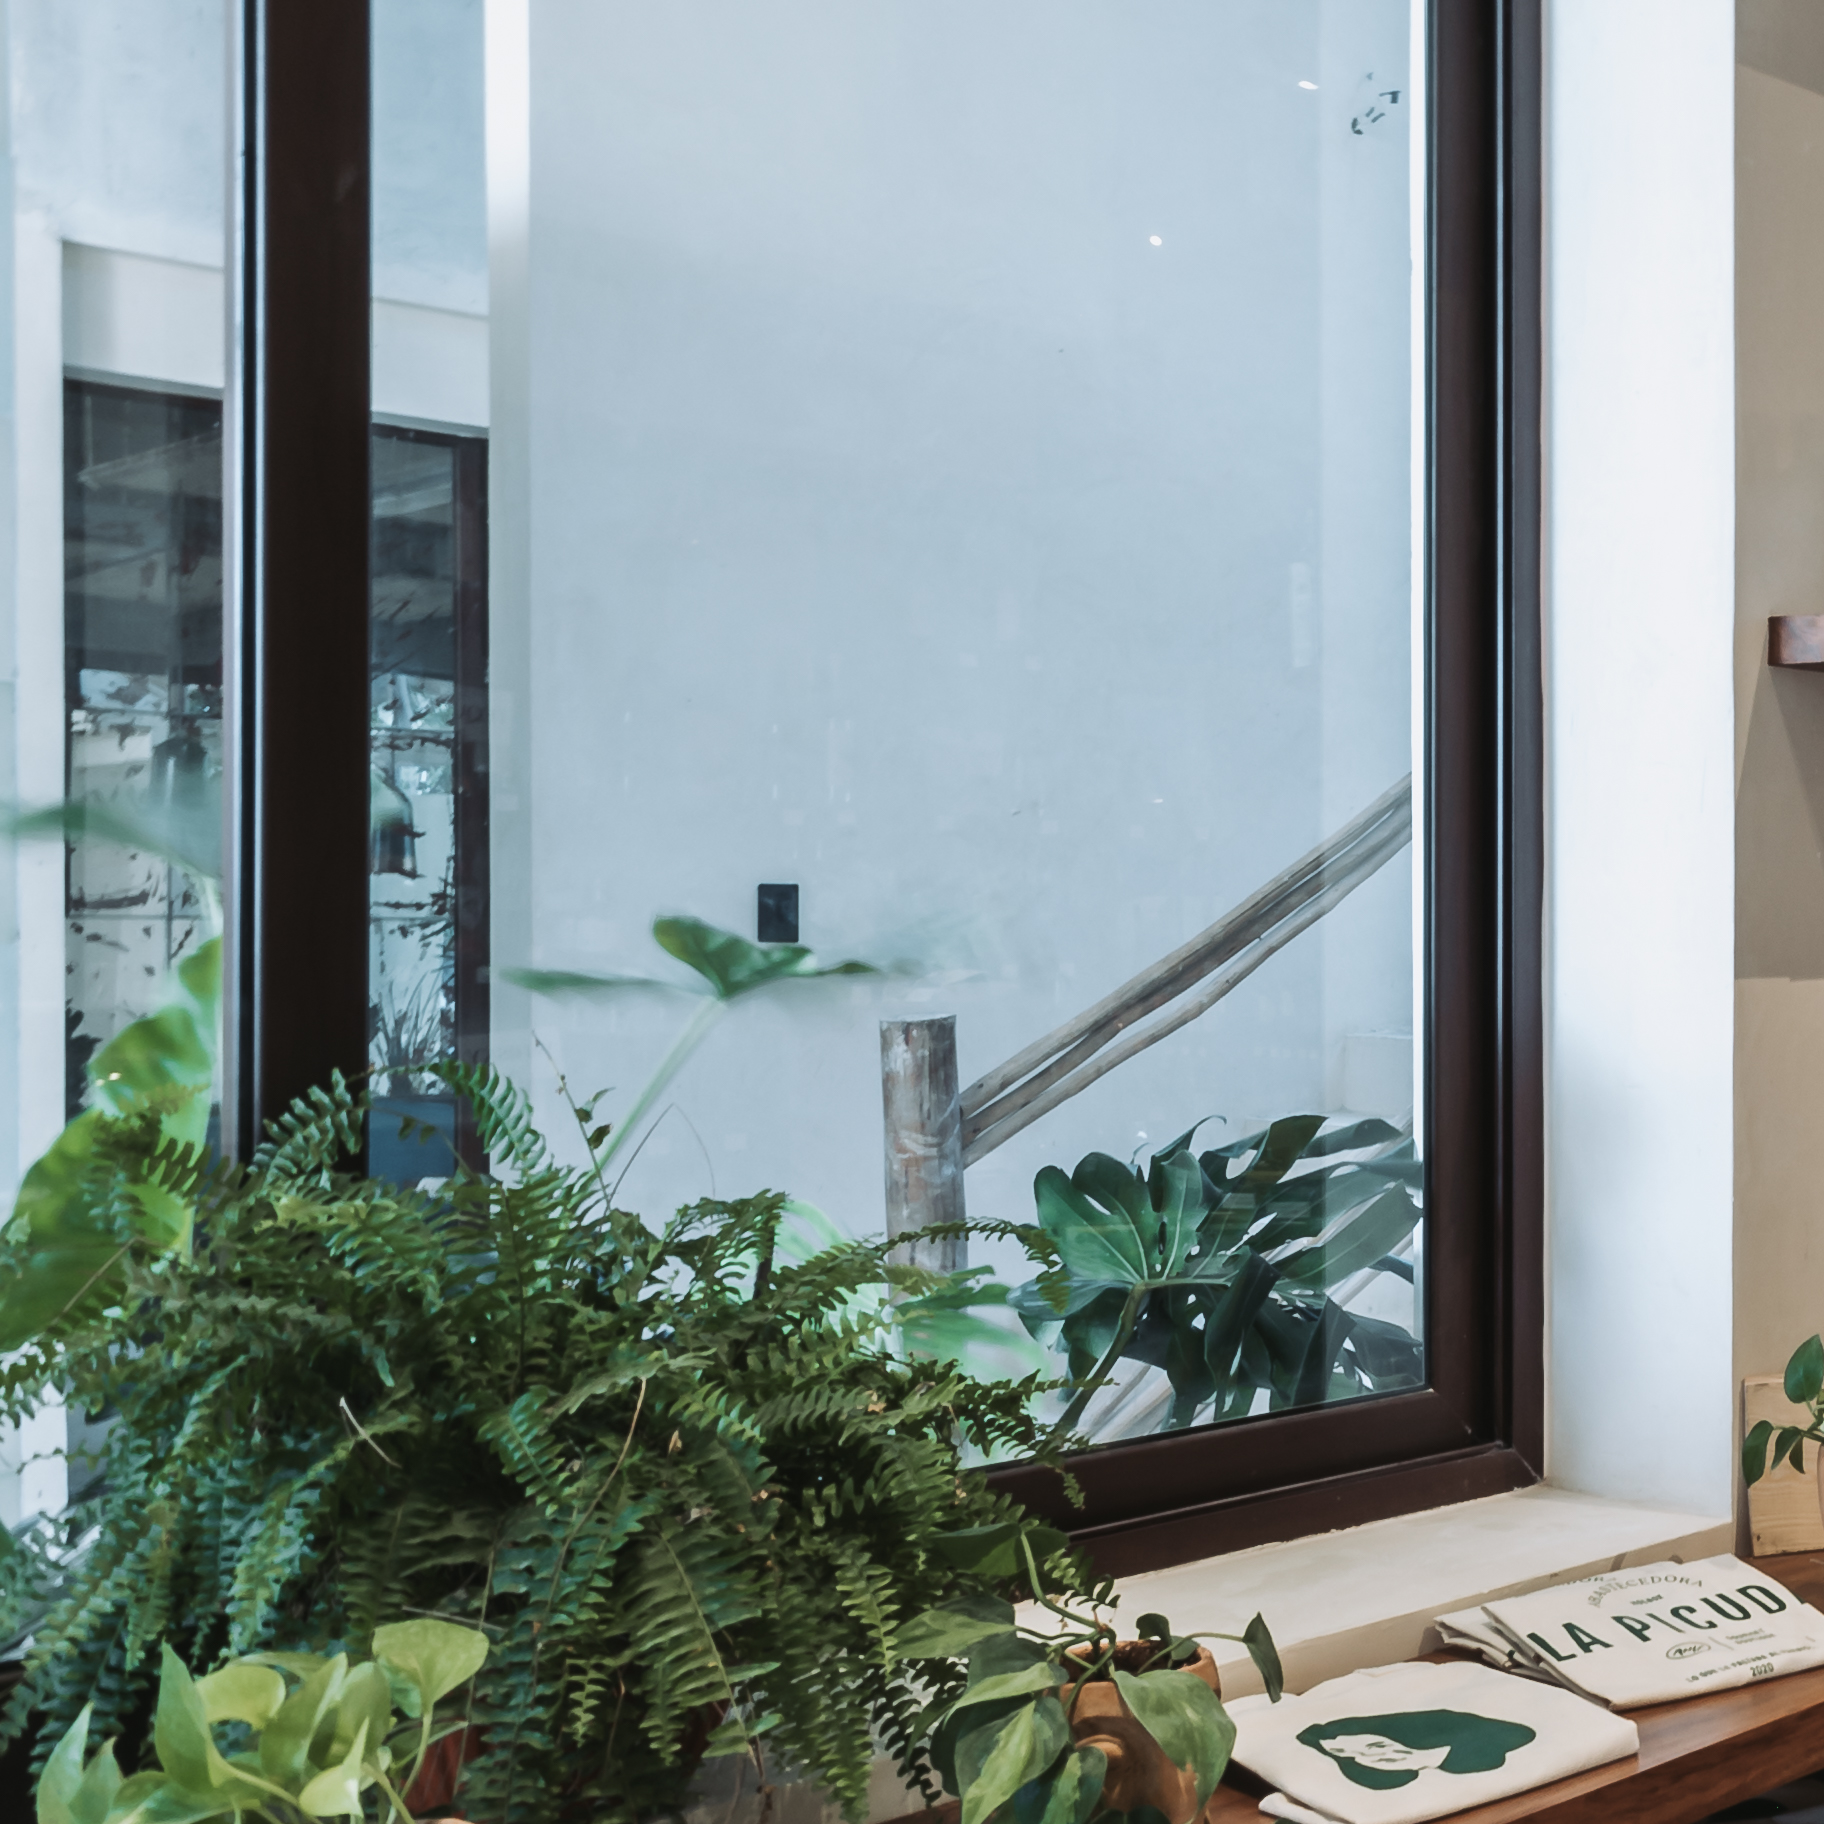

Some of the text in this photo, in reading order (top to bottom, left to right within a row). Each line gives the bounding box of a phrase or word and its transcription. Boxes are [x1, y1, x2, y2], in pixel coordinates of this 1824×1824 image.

[1526, 1584, 1800, 1662] LA PICUD
[1750, 1662, 1775, 1677] 2020
